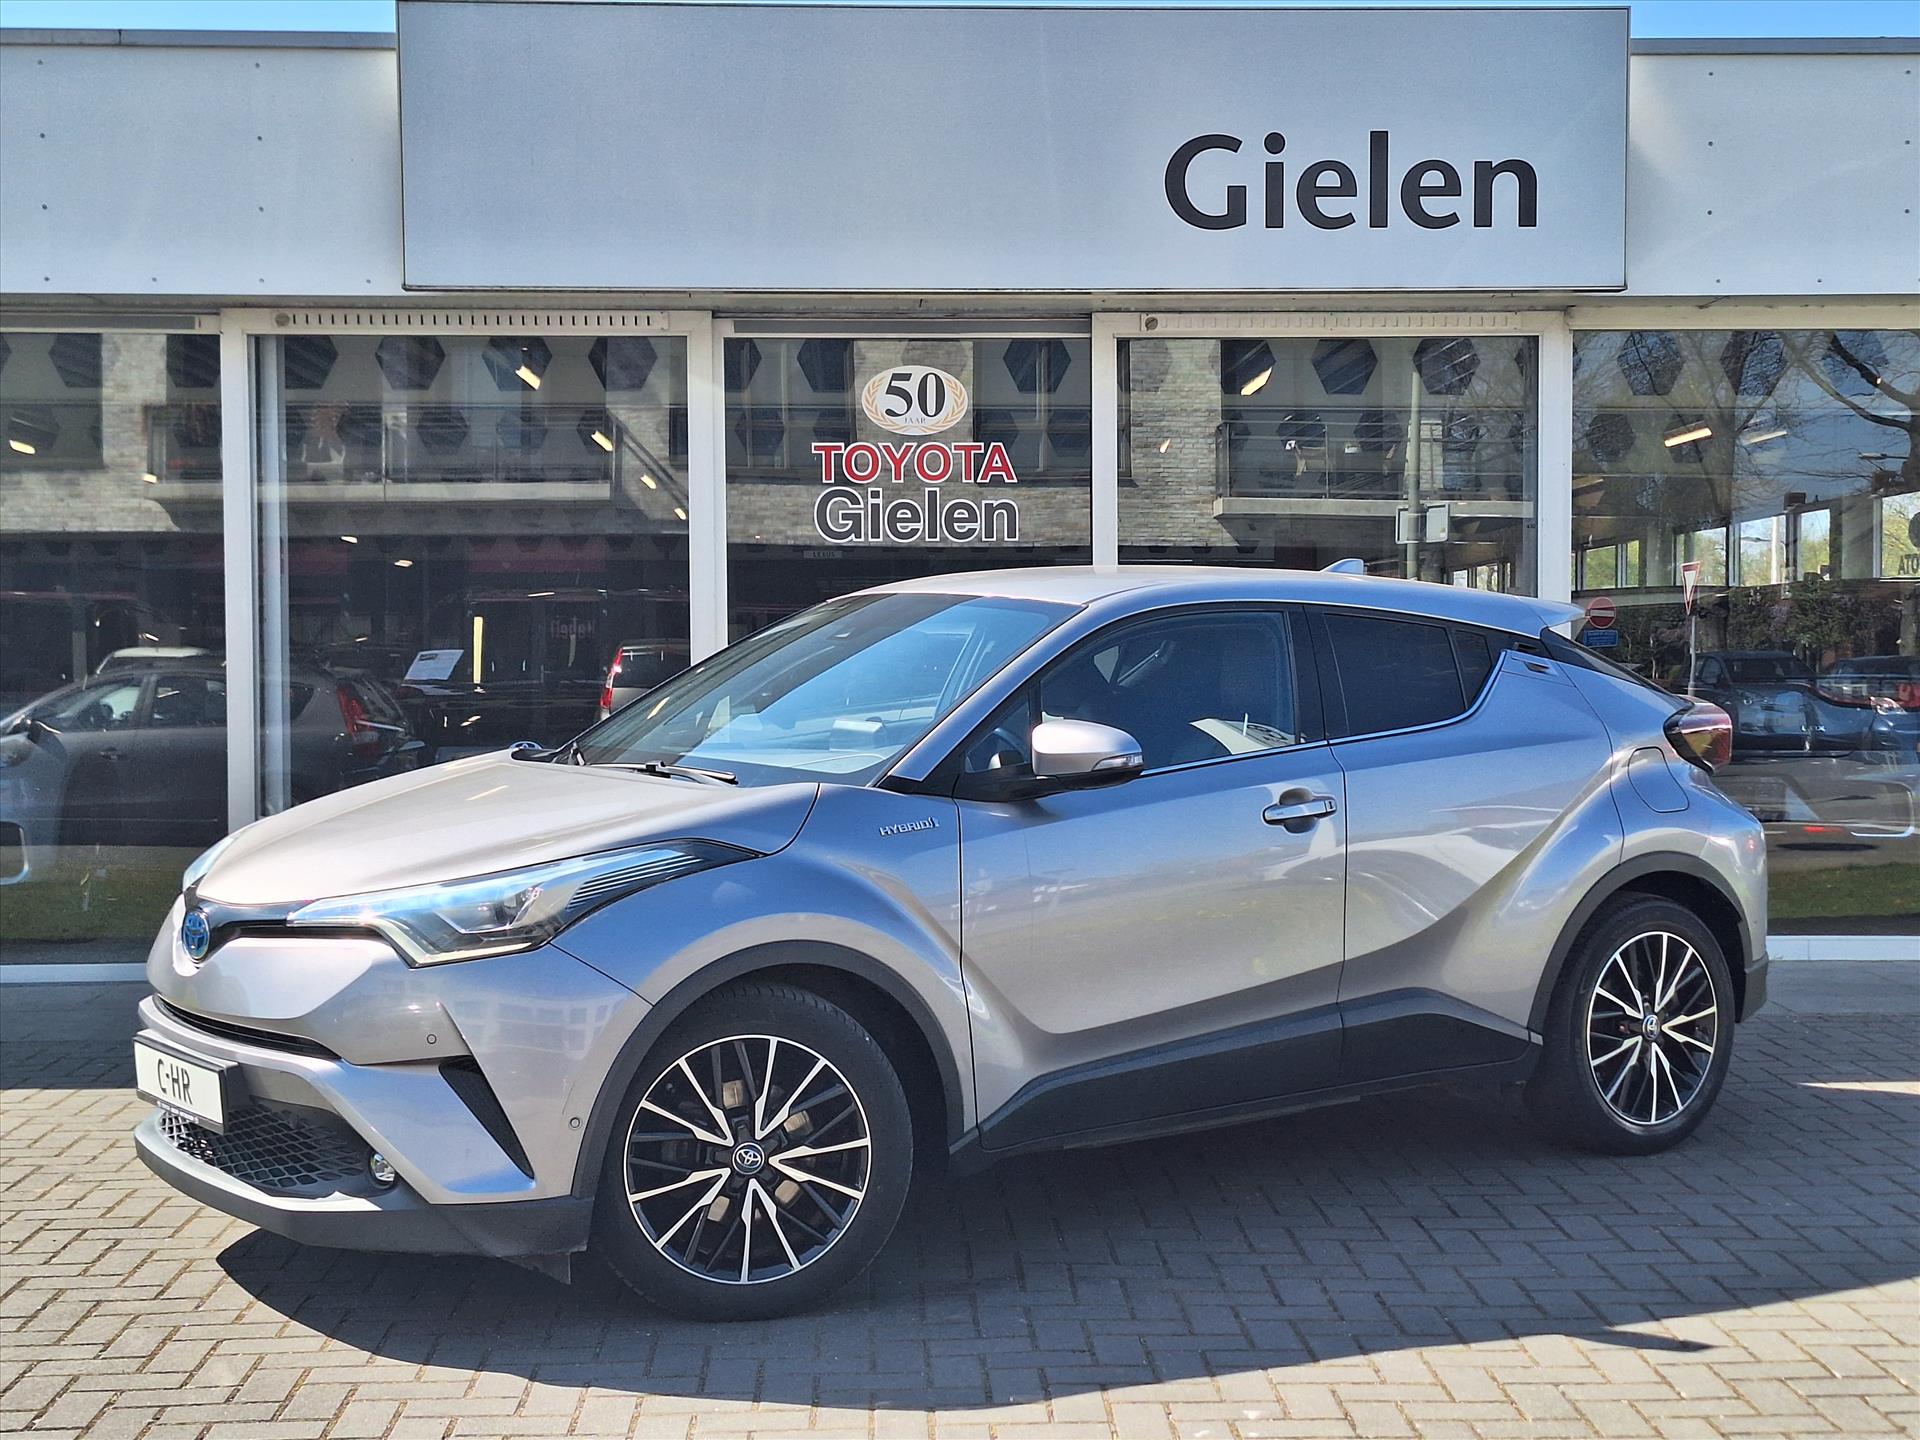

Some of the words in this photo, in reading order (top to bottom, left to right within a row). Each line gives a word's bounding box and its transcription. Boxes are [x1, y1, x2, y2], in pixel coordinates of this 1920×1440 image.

[1164, 130, 1538, 230] Gielen
[884, 372, 946, 418] 50
[904, 416, 927, 424] JAAR
[811, 442, 1018, 484] TOYOTA
[813, 486, 1020, 543] Gielen
[879, 819, 931, 836] HYBRID
[157, 1057, 193, 1105] C-HR
